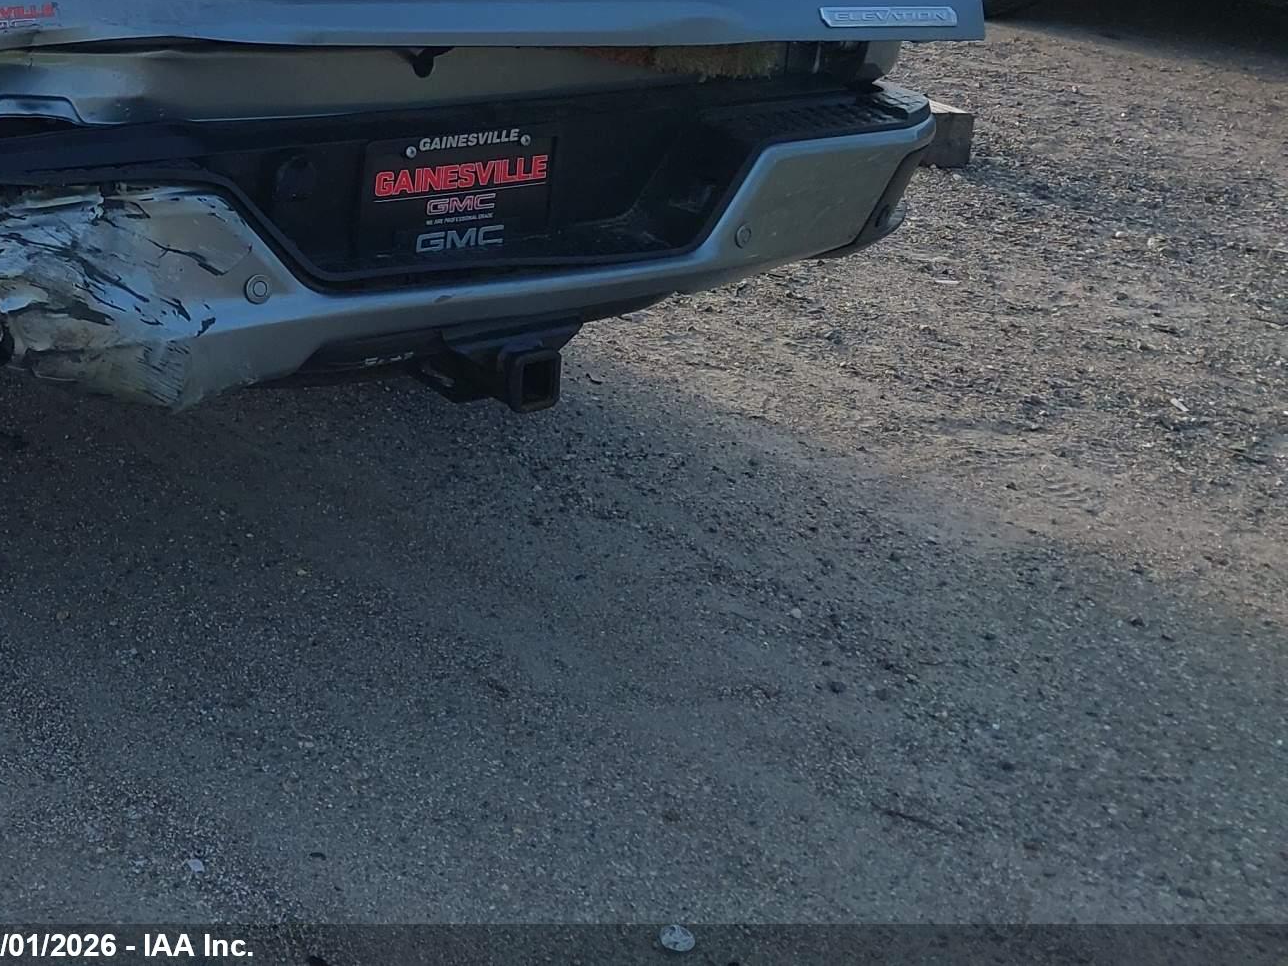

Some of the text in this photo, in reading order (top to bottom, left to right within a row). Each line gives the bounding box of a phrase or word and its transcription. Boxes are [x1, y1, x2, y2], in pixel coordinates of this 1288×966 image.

[833, 9, 948, 22] ELEVATION
[419, 128, 520, 152] GAINESVILLE
[374, 154, 549, 198] GAINESVILLE
[426, 192, 497, 216] GMC
[415, 224, 505, 254] GMC
